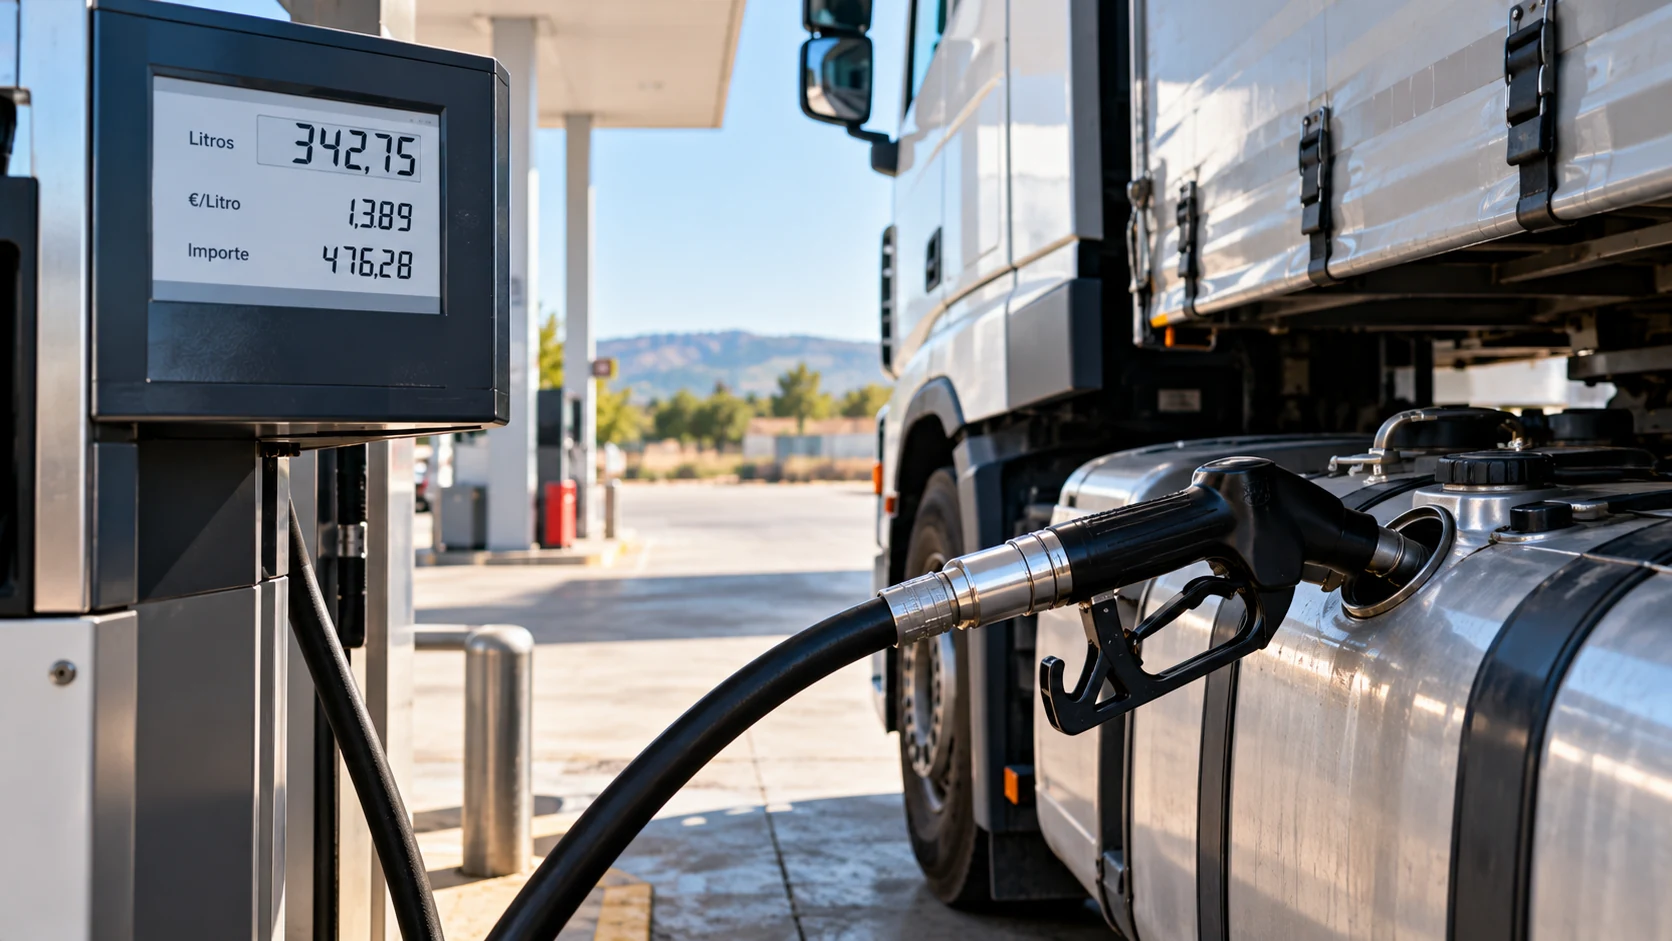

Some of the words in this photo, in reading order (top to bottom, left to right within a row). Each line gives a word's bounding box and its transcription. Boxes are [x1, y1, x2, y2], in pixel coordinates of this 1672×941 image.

[189, 130, 235, 149] Litros
[292, 122, 416, 176] 342,75
[188, 193, 241, 210] €/Litro
[188, 243, 249, 262] Importe
[322, 245, 413, 280] 476,28
